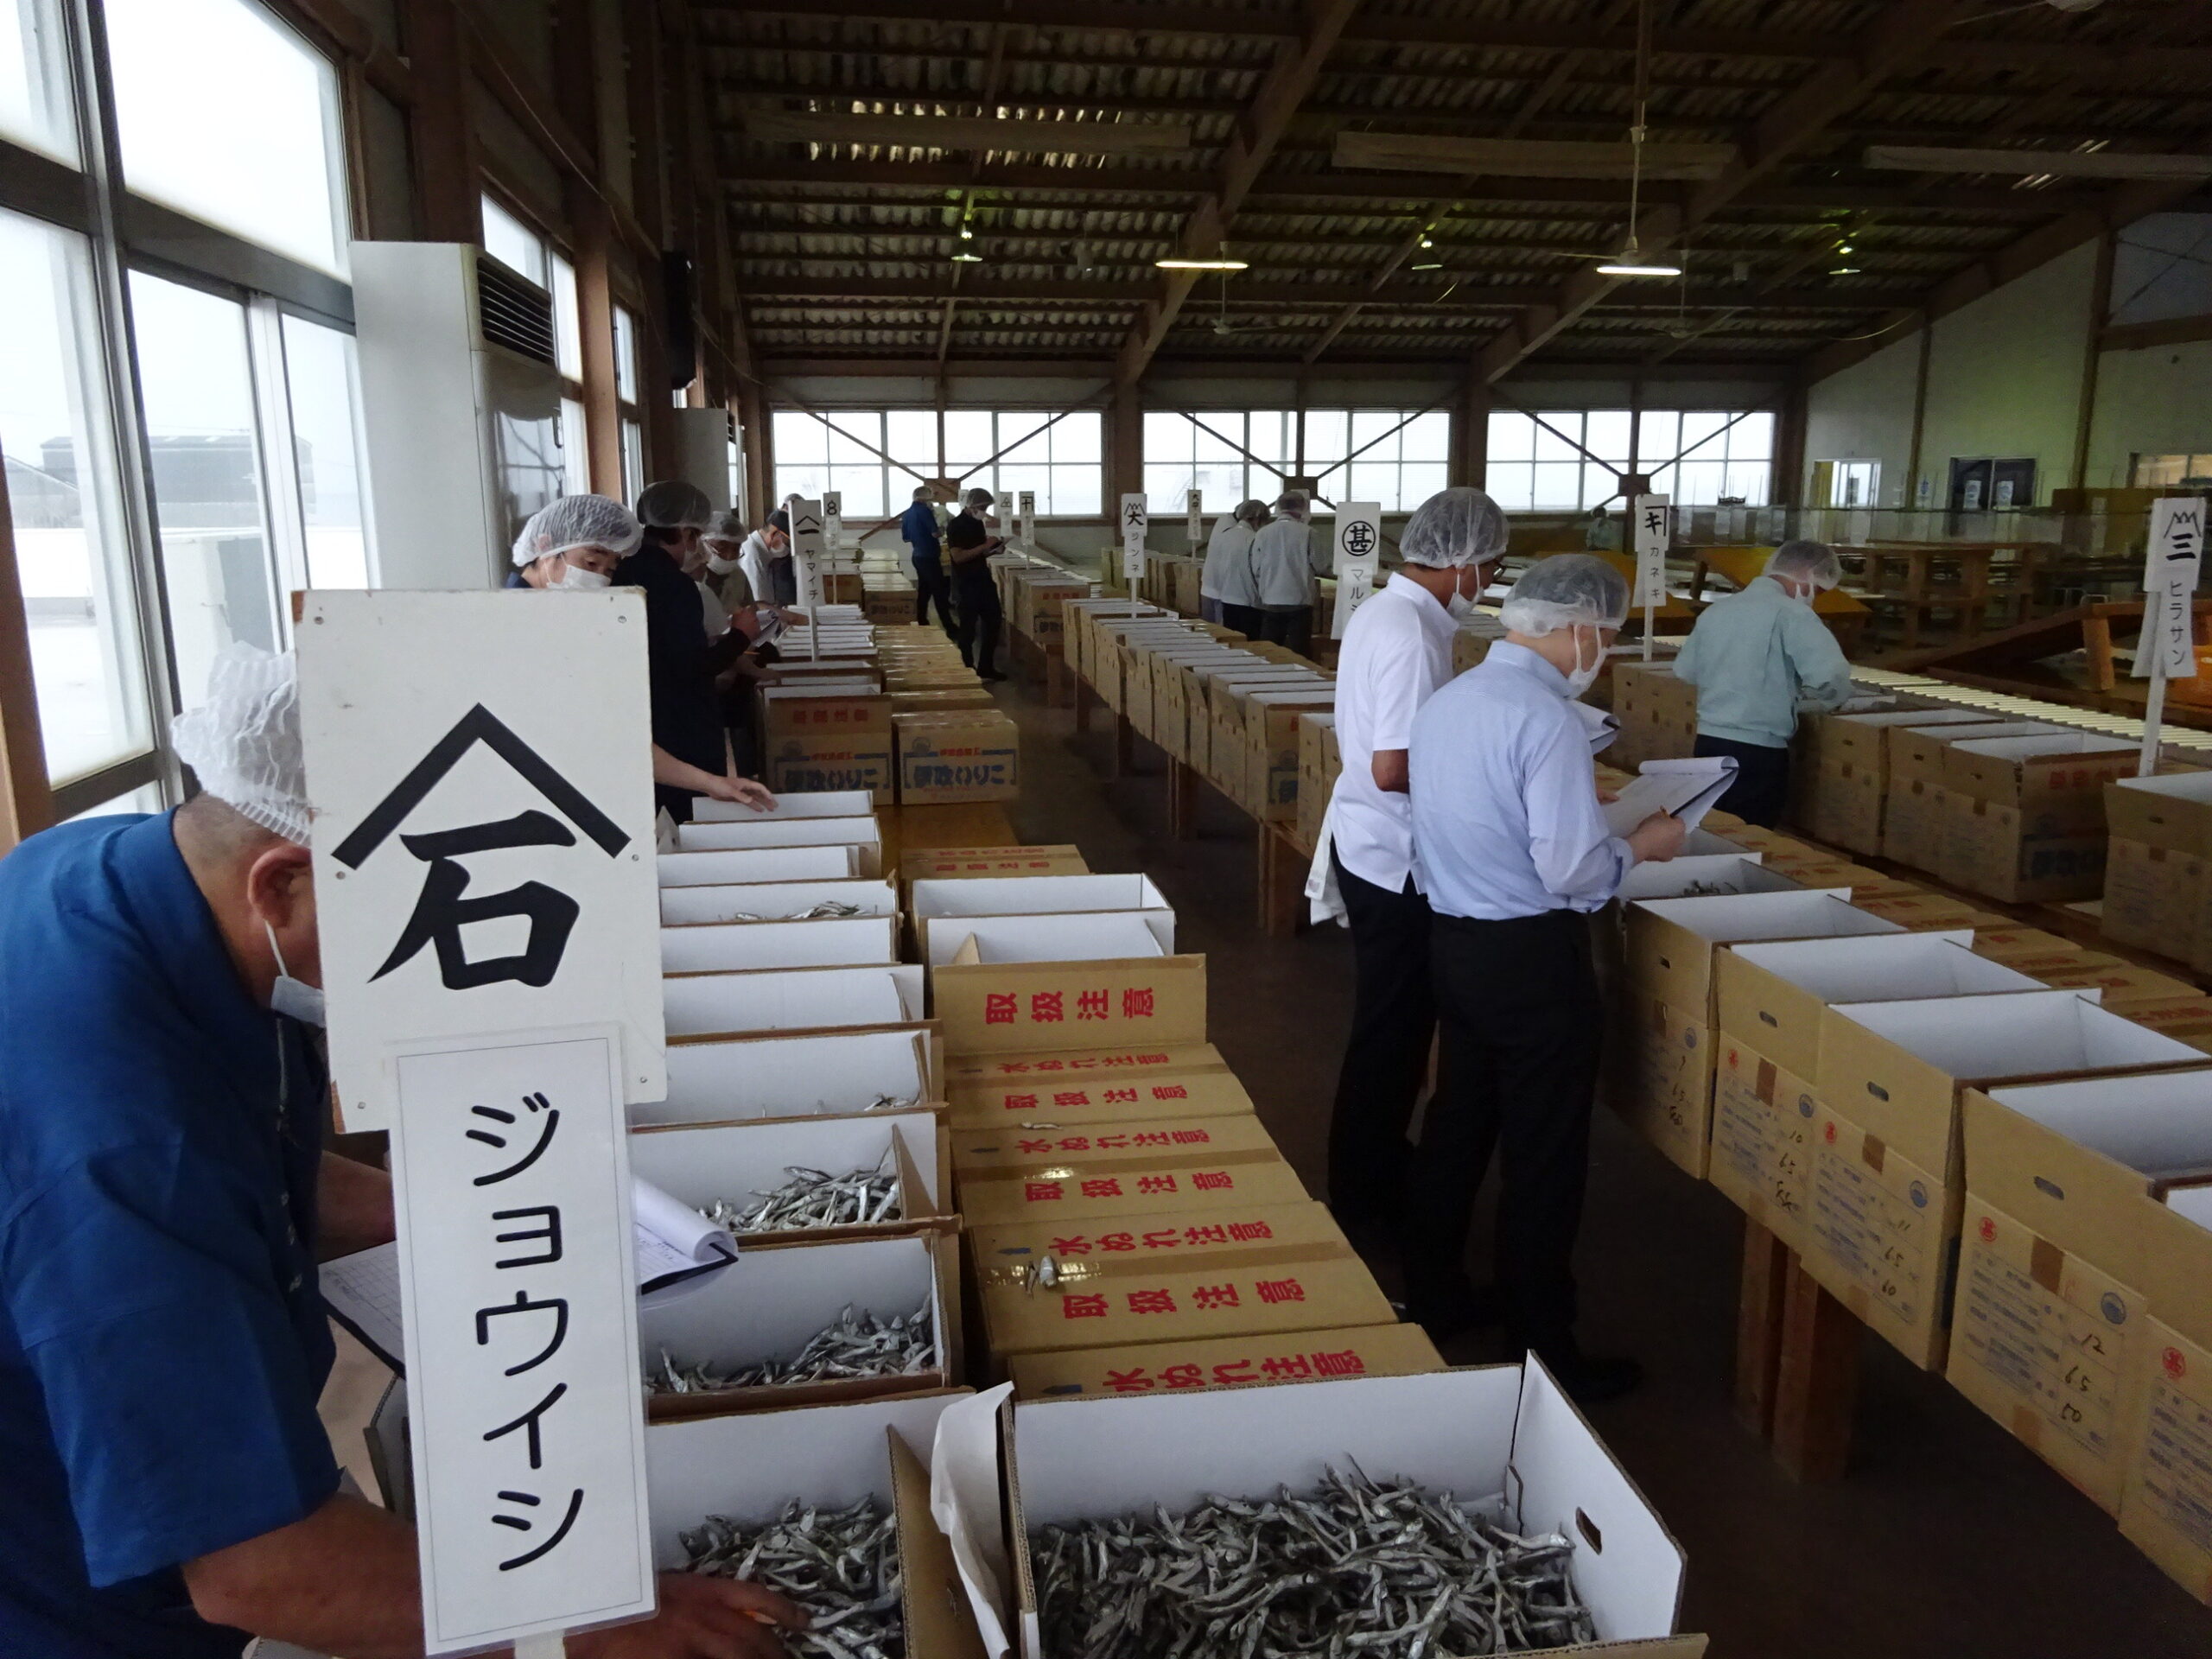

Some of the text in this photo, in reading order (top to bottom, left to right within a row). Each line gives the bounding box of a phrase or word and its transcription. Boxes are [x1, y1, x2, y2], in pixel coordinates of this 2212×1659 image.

[804, 550, 819, 601] ヤマイチ
[1649, 547, 1660, 599] カネキ
[2170, 580, 2185, 665] ヒラサン
[985, 987, 1154, 1025] 取扱注意
[996, 1052, 1170, 1074] 水ぬれ注意
[1004, 1084, 1189, 1110] 取扱注意
[1014, 1128, 1211, 1154] 水ぬれ注意
[1025, 1172, 1235, 1203] 取扱注意
[1048, 1220, 1274, 1256] 水ぬれ注意
[1063, 1277, 1306, 1319] 取扱注意
[463, 1090, 585, 1573] ジョウイシ
[1102, 1349, 1366, 1393] 水ぬれ注意
